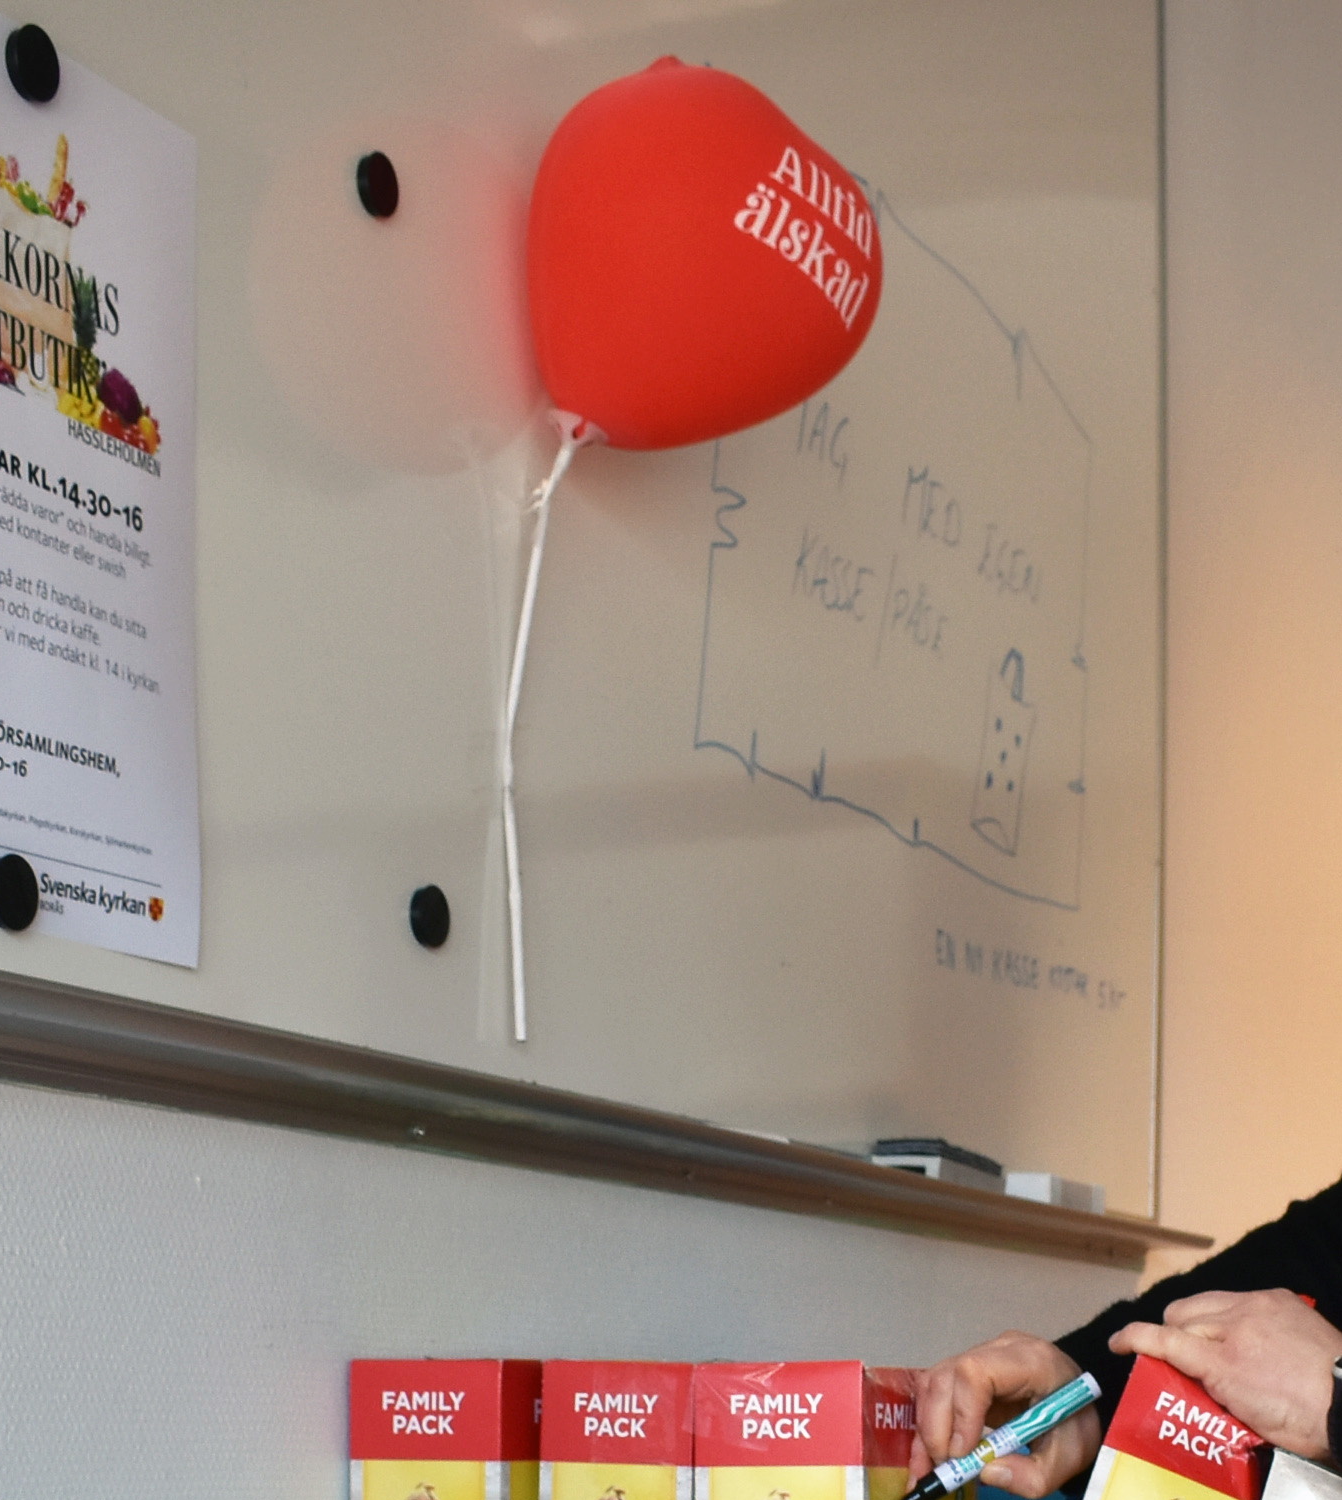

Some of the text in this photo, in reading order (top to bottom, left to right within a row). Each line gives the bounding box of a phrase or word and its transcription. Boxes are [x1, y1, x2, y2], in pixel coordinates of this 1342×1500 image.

[734, 182, 870, 331] älskad
[16, 517, 71, 557] kontanter
[73, 541, 96, 566] eller
[98, 551, 127, 580] swish
[66, 514, 87, 538] och
[88, 522, 122, 555] handla
[7, 598, 31, 621] och
[33, 605, 69, 636] dricka
[71, 619, 103, 647] kaffe.
[16, 572, 33, 596] att
[36, 579, 50, 602] få
[51, 585, 87, 616] handla
[88, 600, 108, 623] kan
[109, 607, 123, 630] du
[124, 616, 147, 641] sitta
[4, 624, 17, 643] vi
[18, 630, 47, 654] med
[49, 641, 87, 670] andakt
[104, 658, 120, 679] 14
[125, 666, 160, 694] kyrkan
[41, 873, 147, 918] Svenska kyrkan
[382, 1391, 466, 1412] FAMILY
[575, 1393, 658, 1414] FAMILY
[730, 1393, 823, 1416] FAMILY
[1155, 1391, 1246, 1447] FAMILY
[392, 1414, 455, 1436] PACK
[585, 1417, 646, 1438] PACK
[742, 1418, 811, 1440] PACK
[1159, 1421, 1225, 1465] PACK
